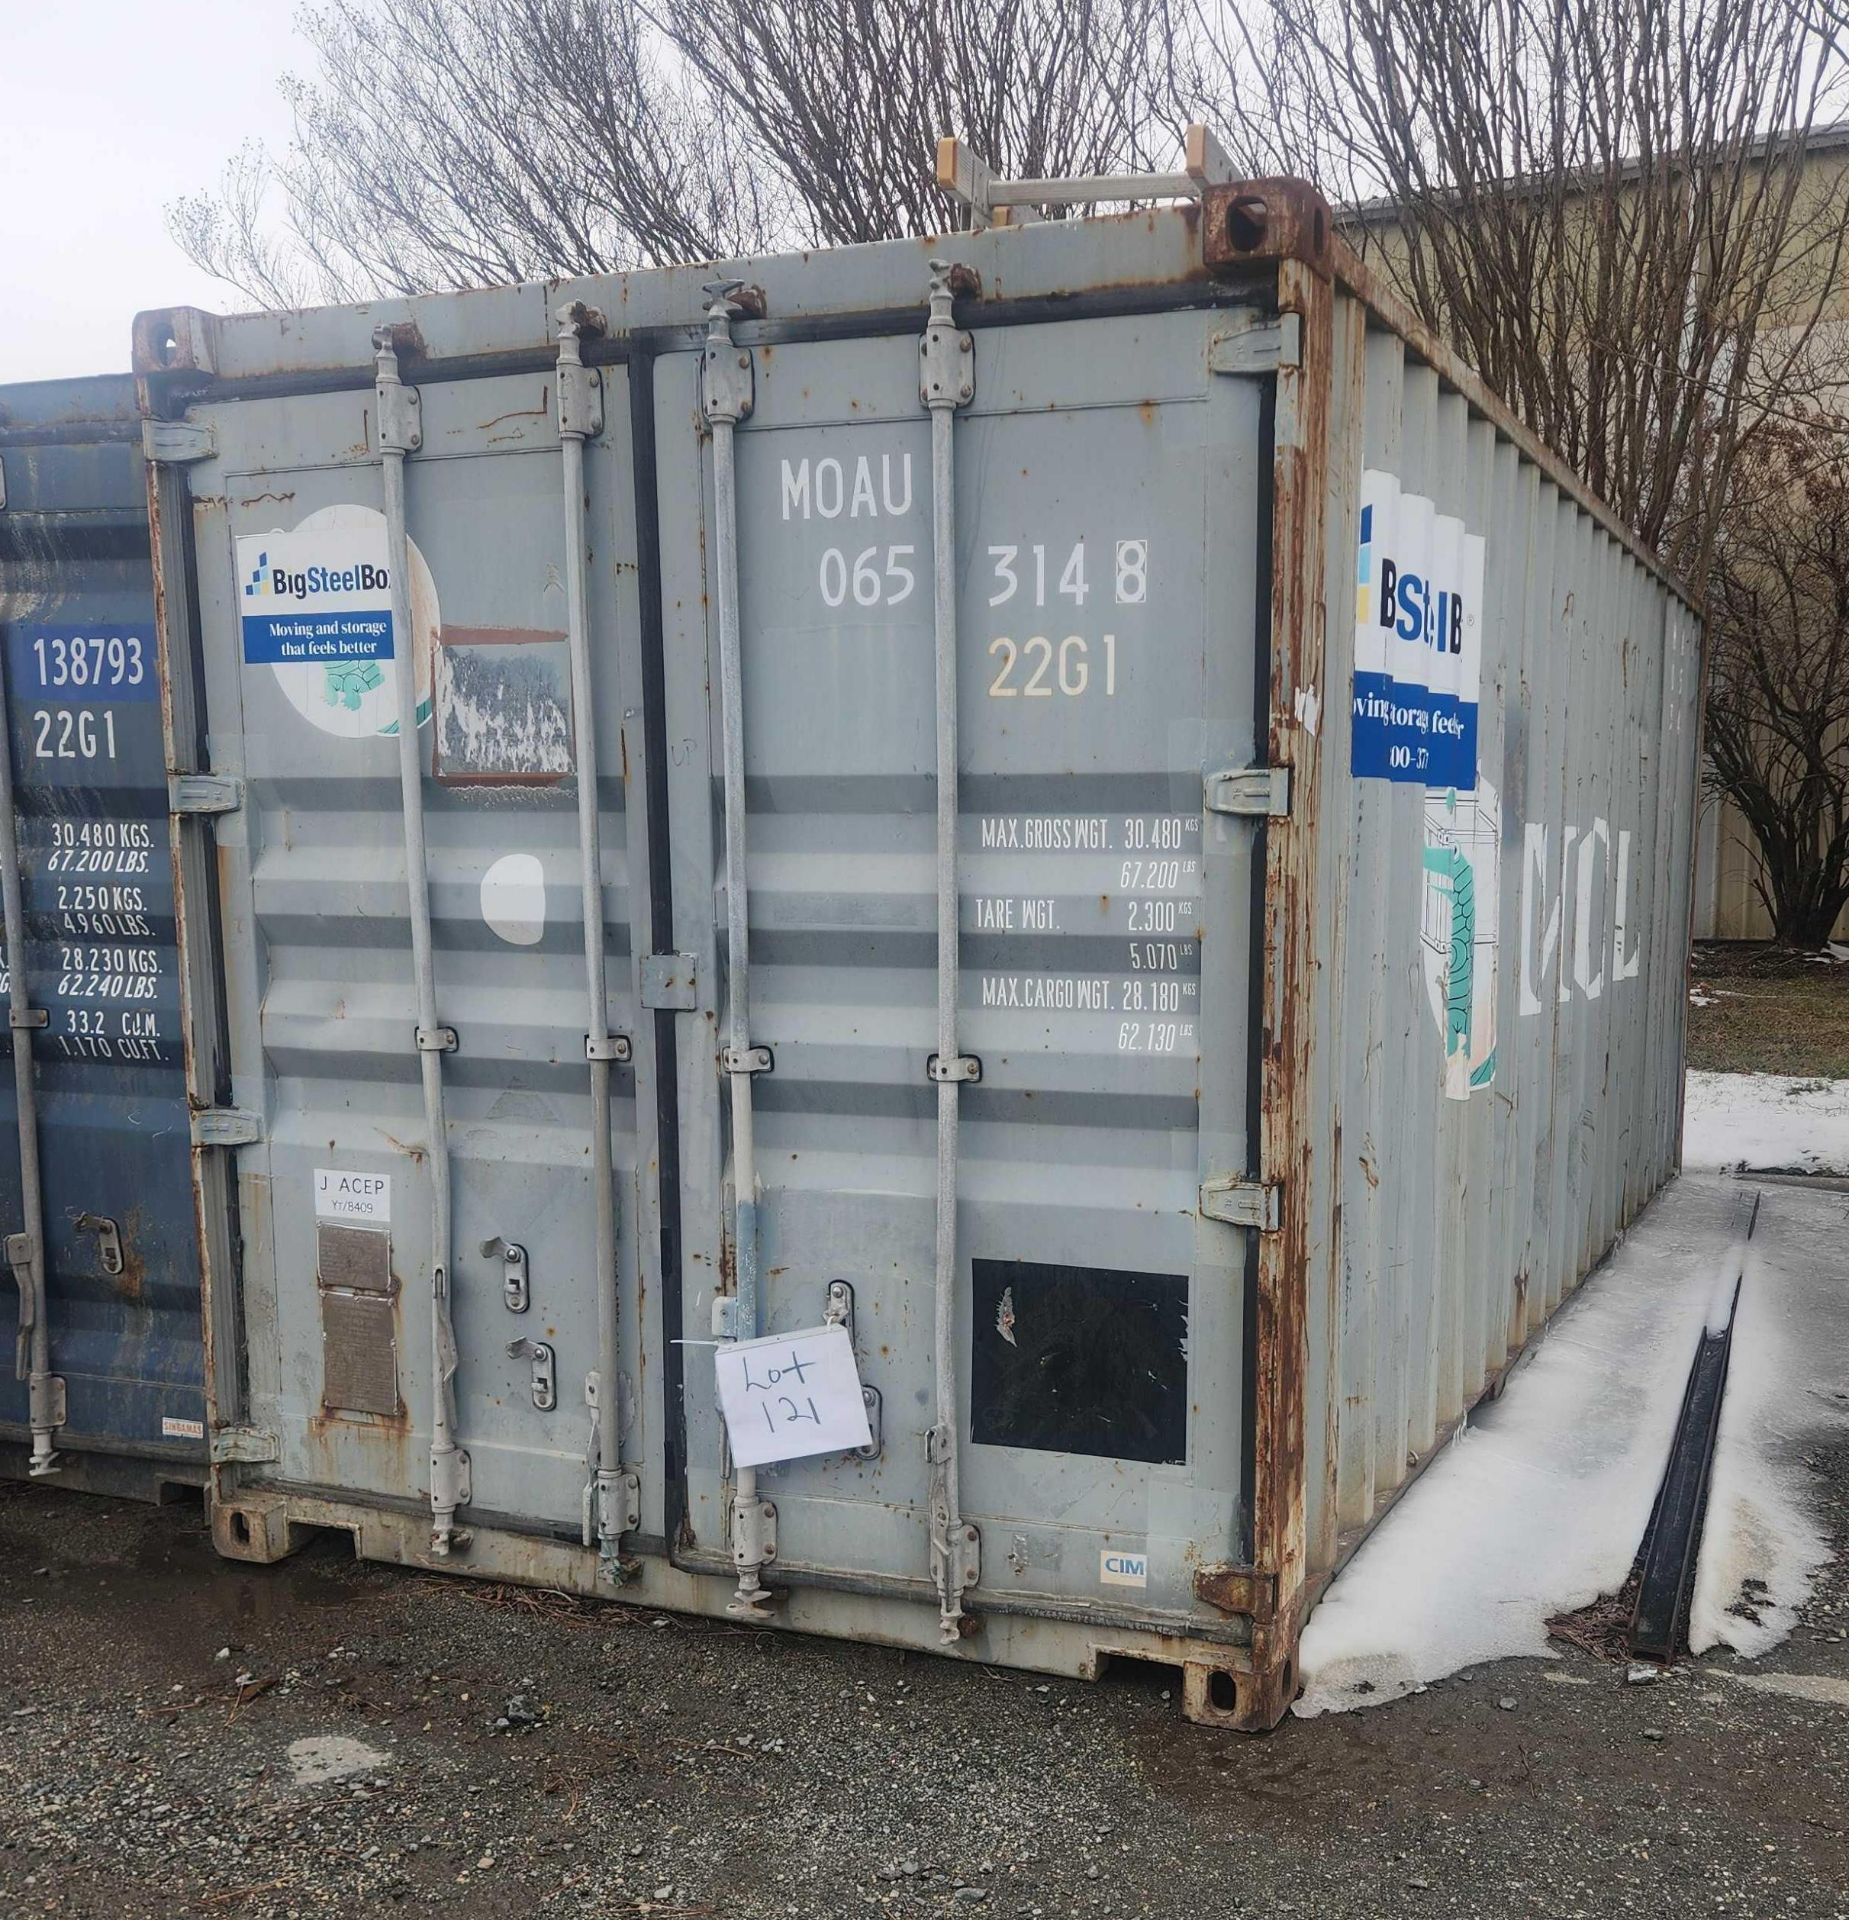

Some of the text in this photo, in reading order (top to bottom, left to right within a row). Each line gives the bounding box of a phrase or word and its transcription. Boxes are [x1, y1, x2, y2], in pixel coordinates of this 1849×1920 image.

[780, 453, 913, 521] MOAU
[819, 540, 1148, 608] 065 314 8
[269, 619, 388, 639] Moving and storage
[281, 639, 378, 656] that feels better
[33, 637, 145, 687] 138793
[987, 634, 1116, 697] 22G1
[33, 709, 116, 759] 22G1
[120, 824, 155, 848] KGS.
[1124, 819, 1182, 849] 30.480
[1184, 819, 1199, 832] KGS
[115, 850, 150, 874] LBS.
[1120, 860, 1197, 889] 67.200 LBS
[113, 887, 148, 912] KGS.
[116, 914, 156, 937] LBS.
[976, 899, 1193, 932] TARE WGT. 2.300 KGS
[128, 949, 163, 974] KGS.
[1129, 943, 1178, 970] 5.070
[124, 975, 158, 999] LBS.
[1123, 981, 1179, 1012] 28.180
[1182, 982, 1197, 996] KGS
[66, 1009, 105, 1035] 33.2
[1118, 1022, 1176, 1052] 62.130
[320, 1175, 385, 1195] J ACEP
[742, 1350, 816, 1393] Lot
[762, 1396, 822, 1434] 121
[1105, 1558, 1145, 1576] CIM
